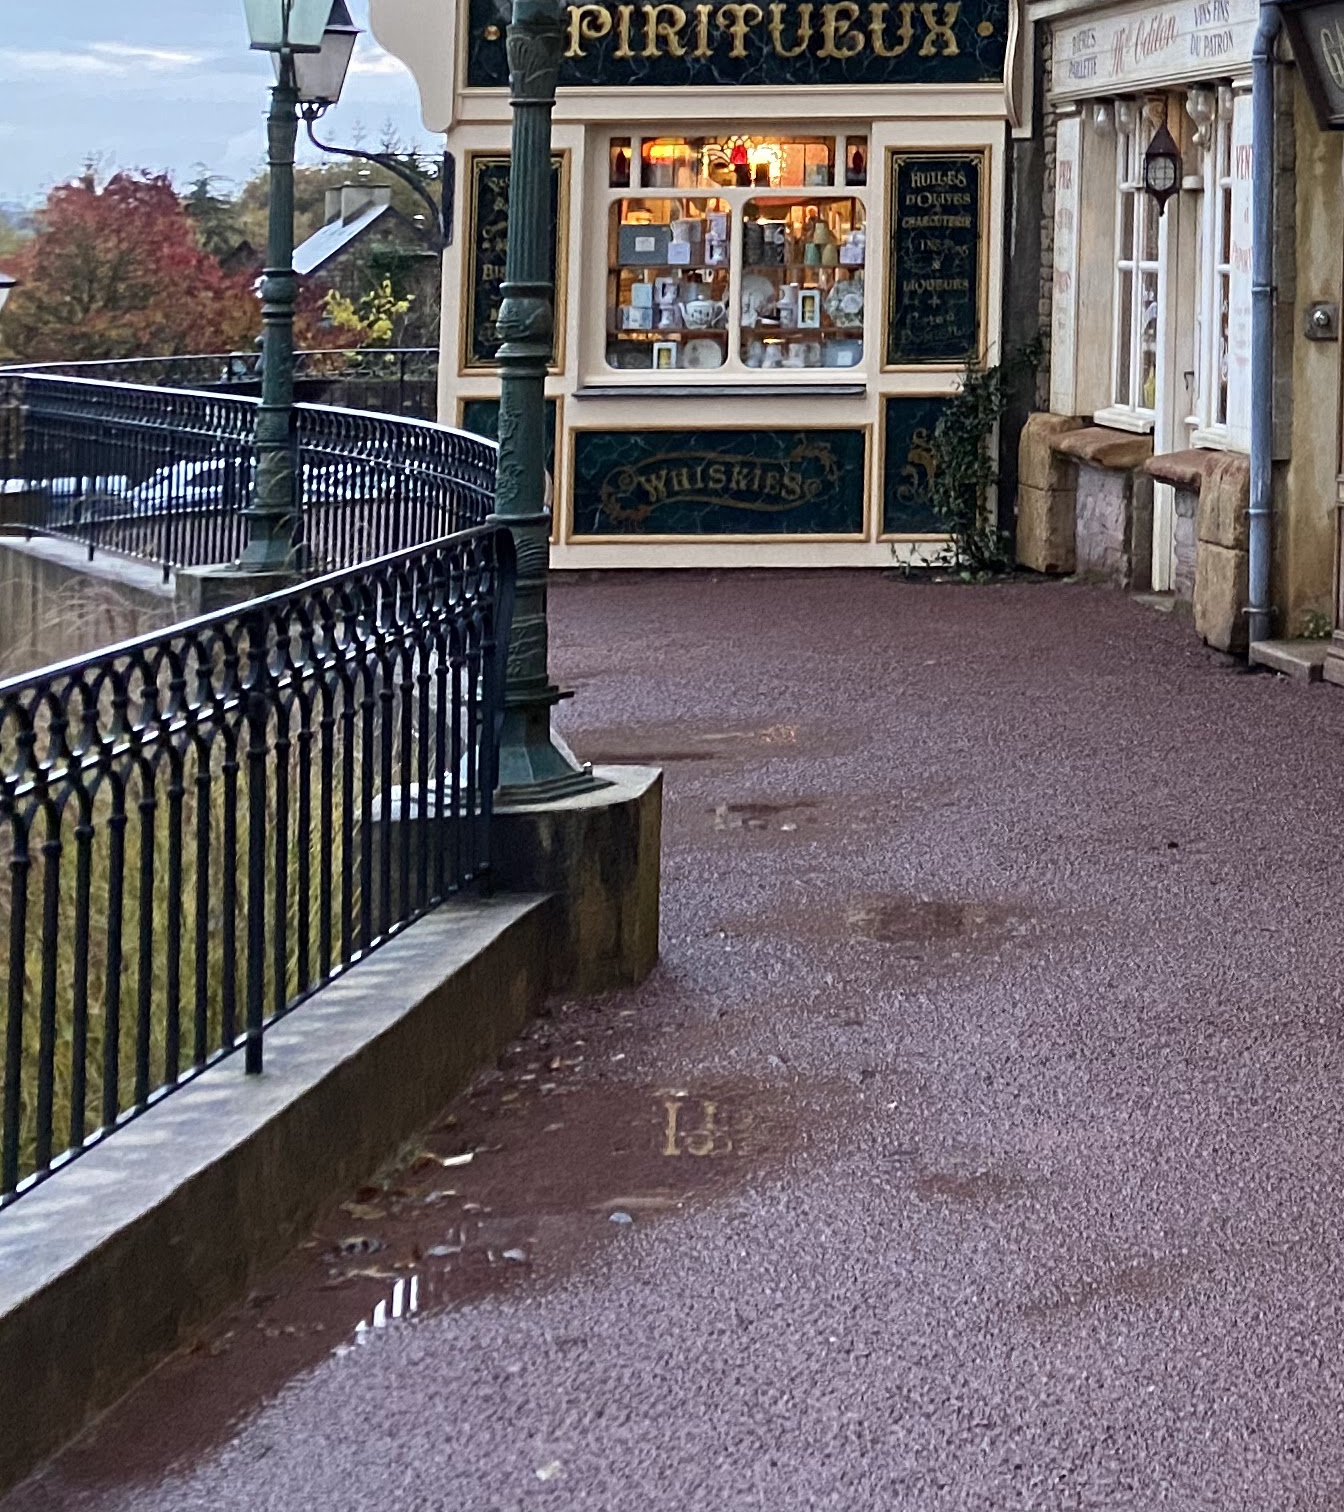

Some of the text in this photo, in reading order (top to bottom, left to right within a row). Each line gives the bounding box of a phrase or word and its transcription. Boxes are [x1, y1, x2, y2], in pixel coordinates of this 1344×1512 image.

[564, 1, 961, 60] PIRITUEUX
[911, 170, 967, 188] HUILES
[637, 464, 802, 501] WHISKIES
